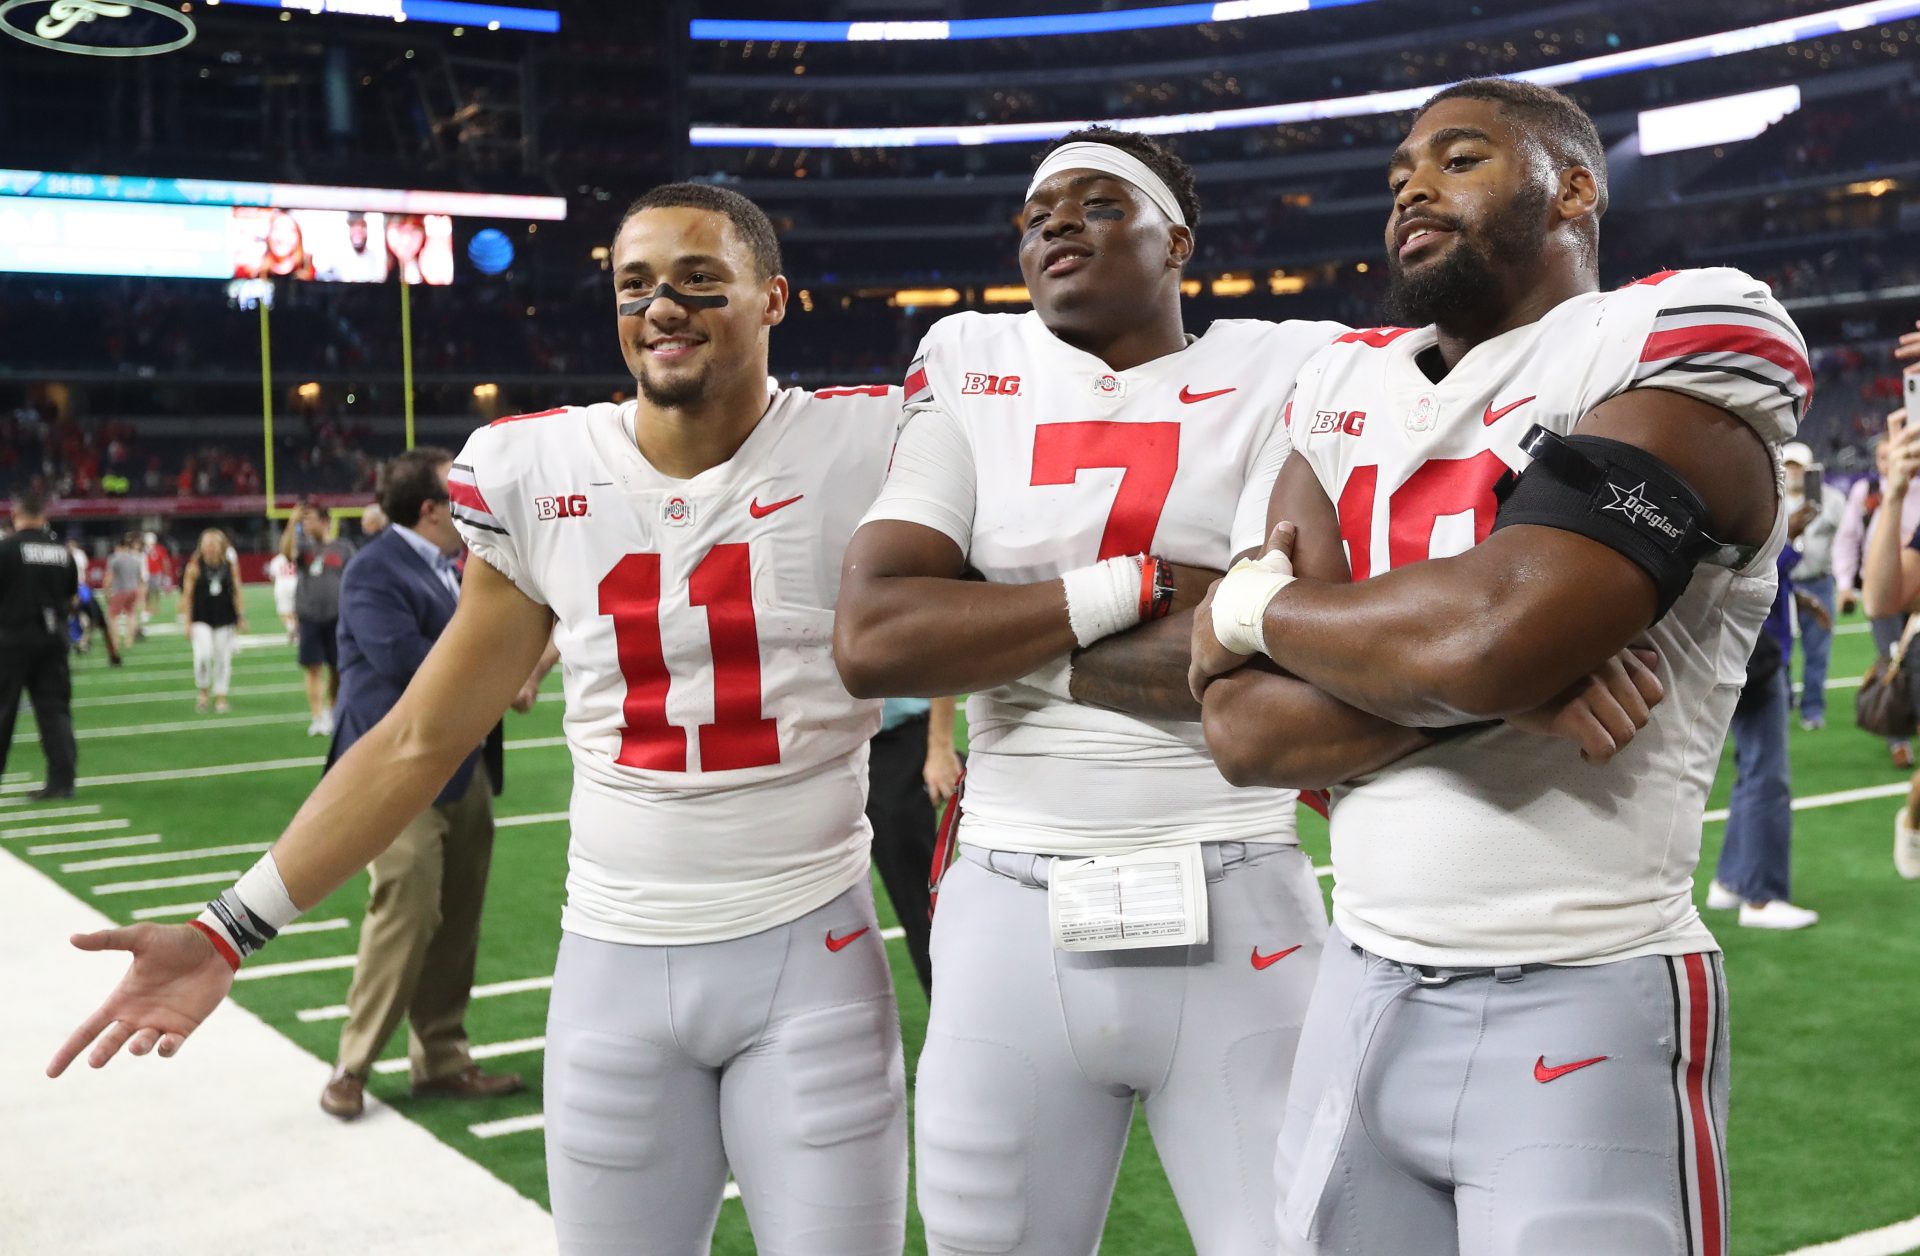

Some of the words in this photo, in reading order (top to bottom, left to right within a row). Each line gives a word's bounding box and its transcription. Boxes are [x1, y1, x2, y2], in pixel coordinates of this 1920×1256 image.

[1030, 420, 1180, 563] 7
[1623, 495, 1679, 538] Douglas
[598, 542, 780, 772] 11
